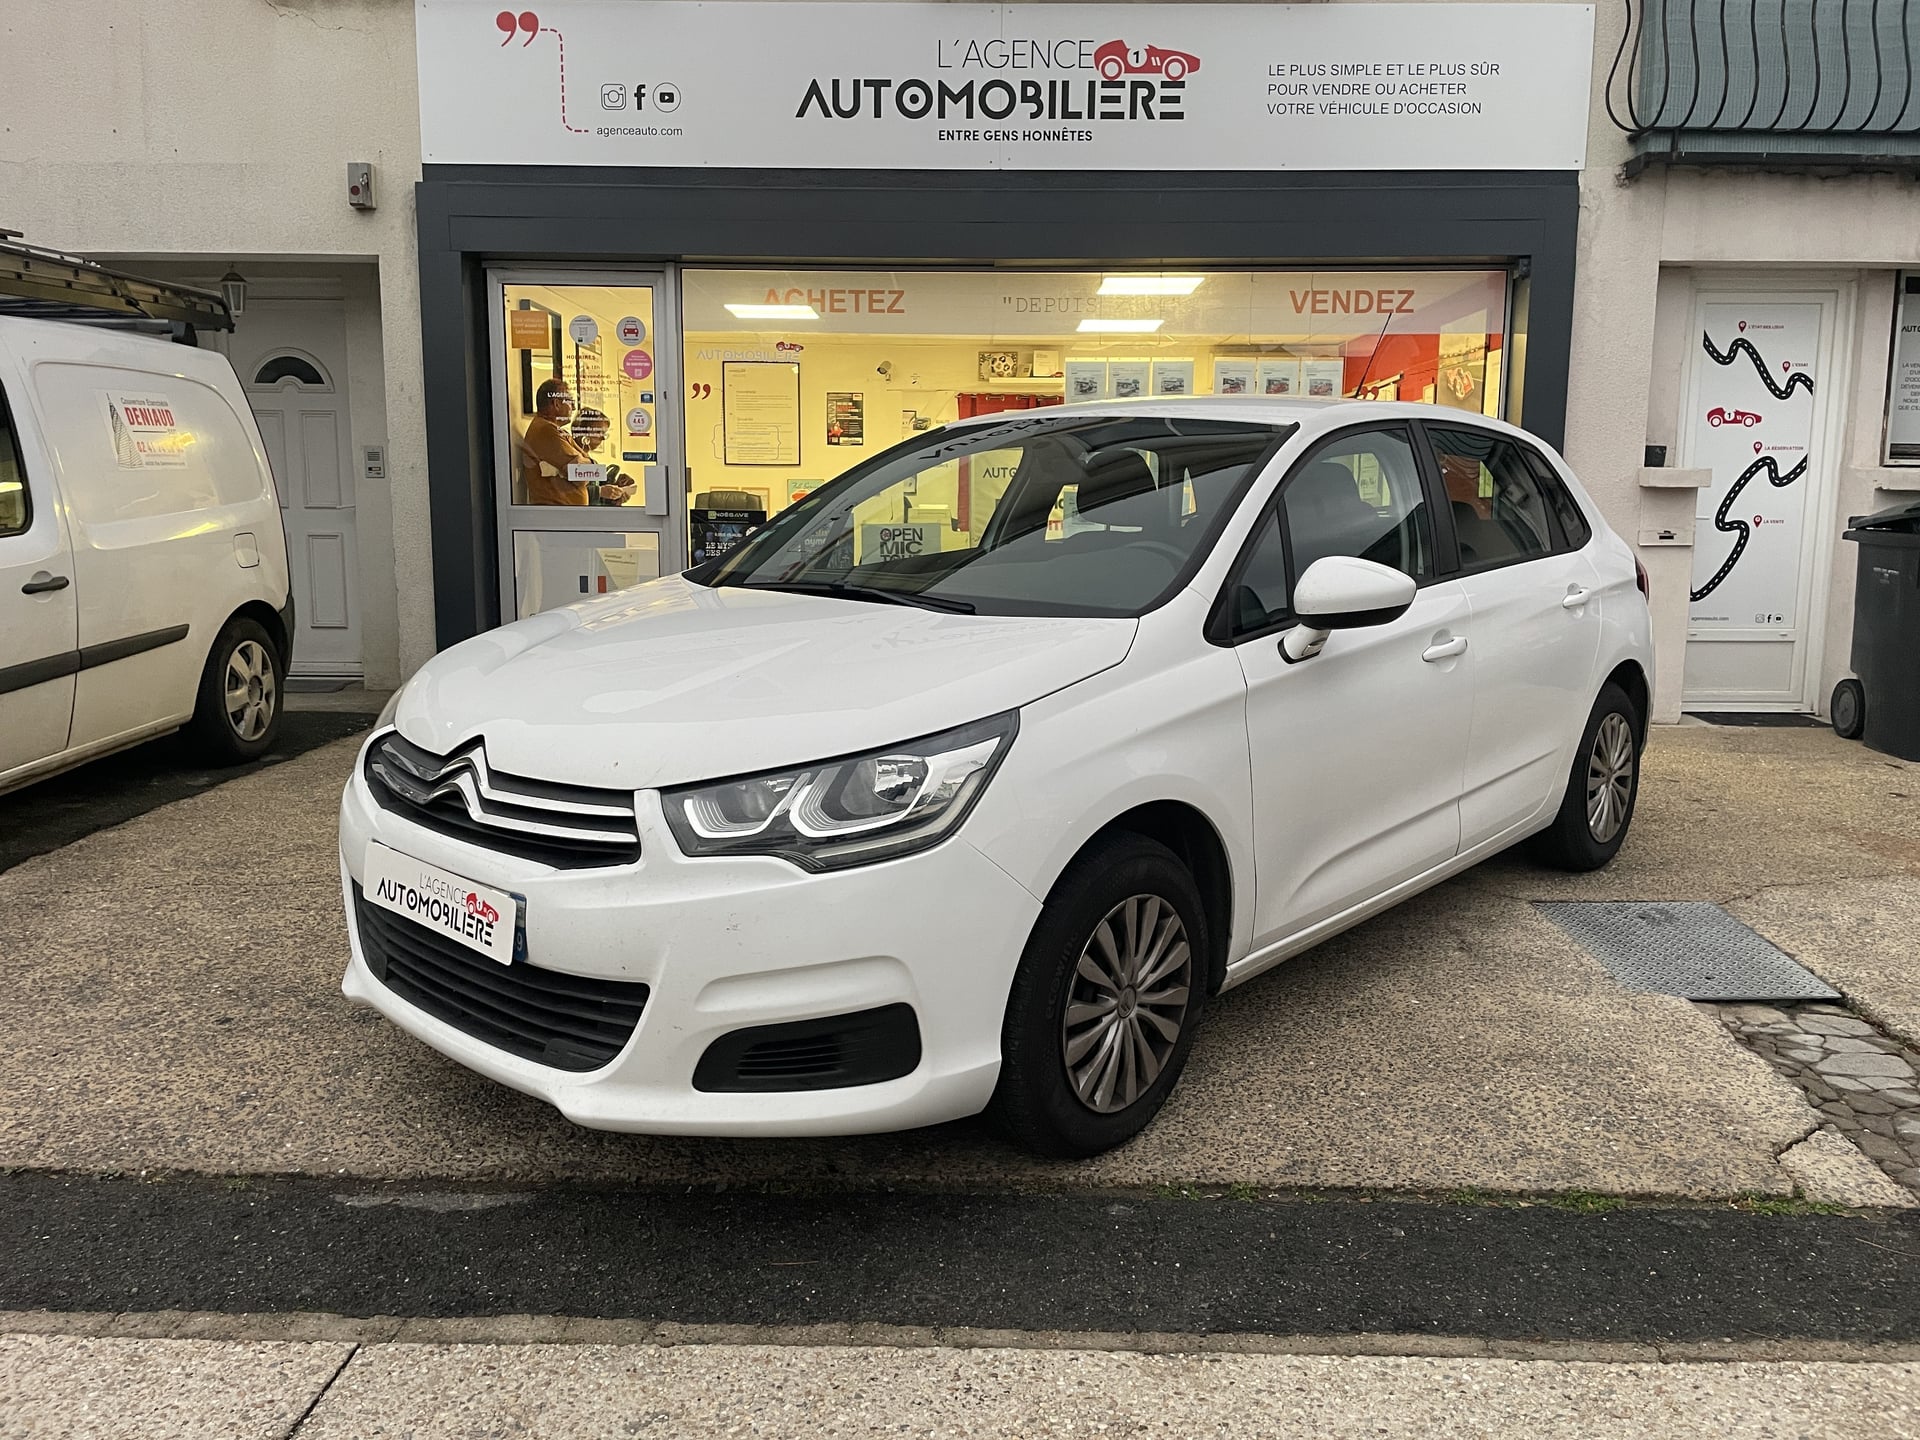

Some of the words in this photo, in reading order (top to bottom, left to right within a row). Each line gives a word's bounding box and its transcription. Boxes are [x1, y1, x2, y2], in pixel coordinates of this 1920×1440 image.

[937, 39, 1095, 69] L'AGENCE
[1268, 64, 1286, 76] LE
[1290, 64, 1326, 76] PLUS
[1330, 64, 1382, 76] SIMPLE
[1386, 64, 1405, 76] ET
[1408, 64, 1425, 76] LE
[1429, 64, 1466, 76] PLUS
[1470, 61, 1500, 76] SÛR
[1267, 83, 1308, 95] POUR
[1312, 83, 1371, 95] VENDRE
[1375, 83, 1396, 95] OU
[1399, 83, 1467, 95] ACHETER
[1267, 103, 1315, 115] VOTRE
[1319, 101, 1389, 115] VÉHICULE
[1393, 102, 1482, 115] D'OCCASION
[596, 126, 683, 137] agenceauto.com
[938, 130, 980, 141] ENTRE
[983, 130, 1019, 141] GENS
[1022, 127, 1093, 141] HONNÊTES
[764, 288, 905, 314] ACHETEZ
[1289, 290, 1415, 314] VENDEZ
[124, 407, 175, 427] DENIAUD
[574, 467, 600, 478] fermé
[880, 528, 923, 542] OPEN
[880, 541, 923, 555] MIC
[419, 872, 467, 908] L'AGENCE
